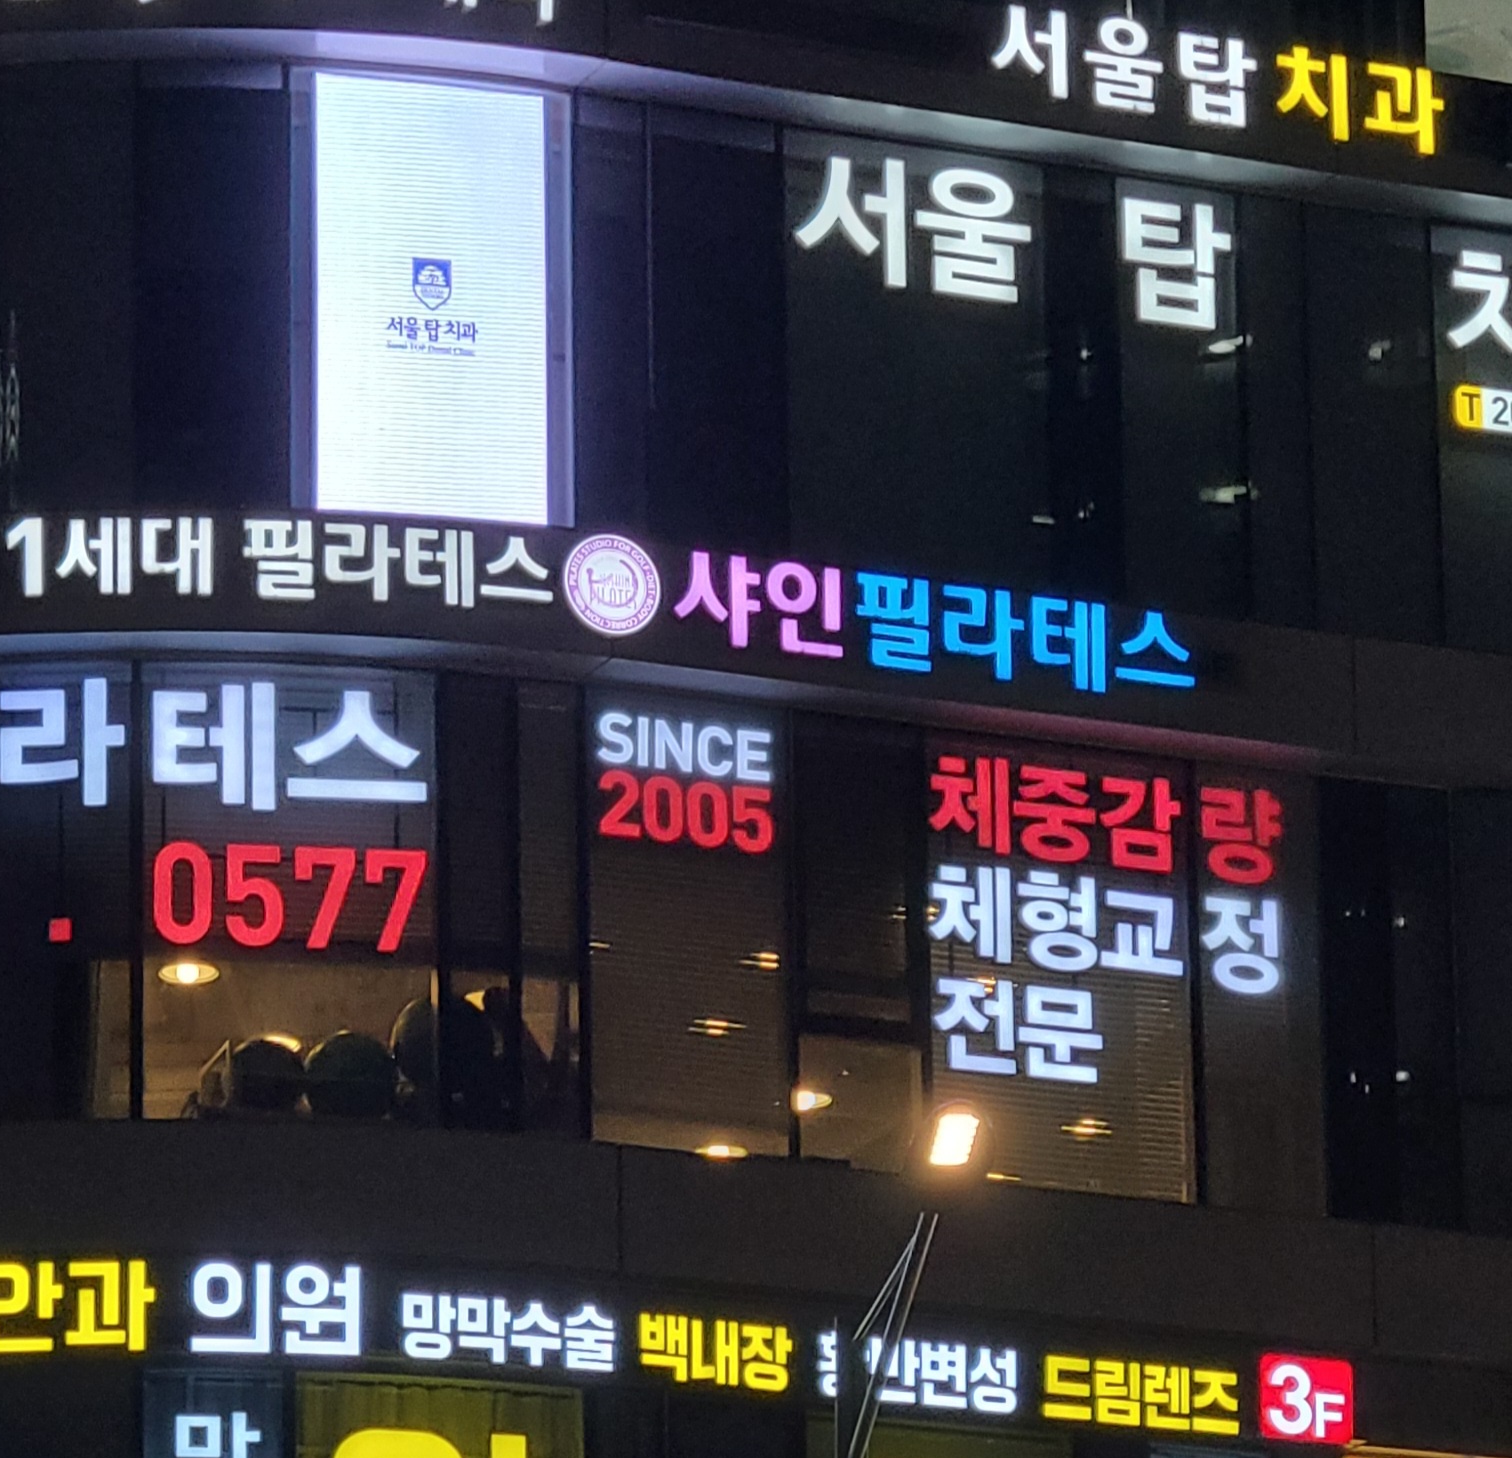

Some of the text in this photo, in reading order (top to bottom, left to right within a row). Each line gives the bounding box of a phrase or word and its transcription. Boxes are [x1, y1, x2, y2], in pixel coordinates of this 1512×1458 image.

[795, 157, 1032, 303] 서울
[1122, 197, 1232, 330] 탑
[386, 316, 478, 344] 서울 탑 치과
[6, 517, 213, 597] 1세대
[243, 518, 554, 608] 필라테스
[597, 712, 772, 783] SINCE
[597, 769, 775, 855] 2005
[929, 756, 1282, 886] 체중감량
[153, 842, 428, 952] 0577
[928, 865, 1281, 995] 체형교정
[932, 977, 1104, 1083] 전문
[189, 1260, 363, 1357] 의원
[401, 1292, 617, 1373] 망막수술
[639, 1312, 793, 1392] 백내장
[1043, 1354, 1241, 1436] 드림렌즈
[1266, 1364, 1346, 1440] 3F
